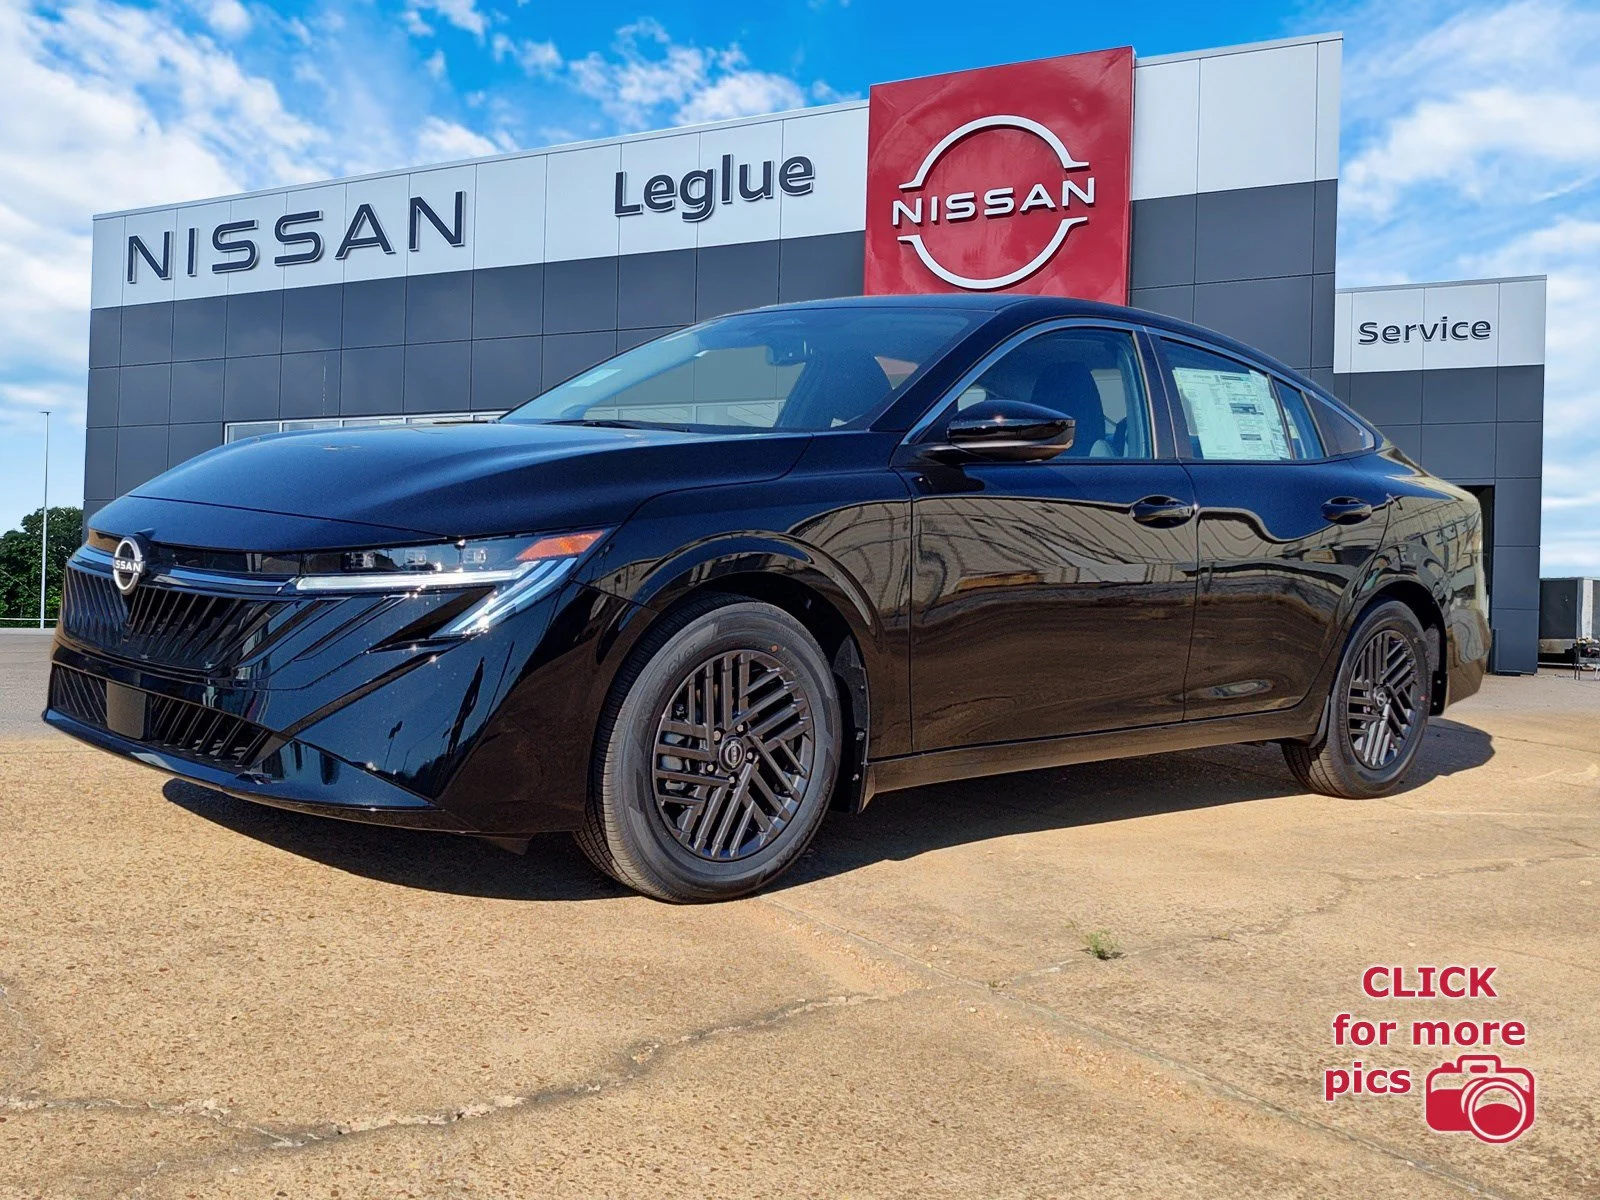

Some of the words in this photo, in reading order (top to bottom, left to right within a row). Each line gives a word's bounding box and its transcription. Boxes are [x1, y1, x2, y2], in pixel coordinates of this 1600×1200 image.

[614, 153, 815, 222] Leglue
[892, 177, 1095, 226] NISSAN
[127, 190, 465, 284] NISSAN
[1358, 316, 1491, 345] Service
